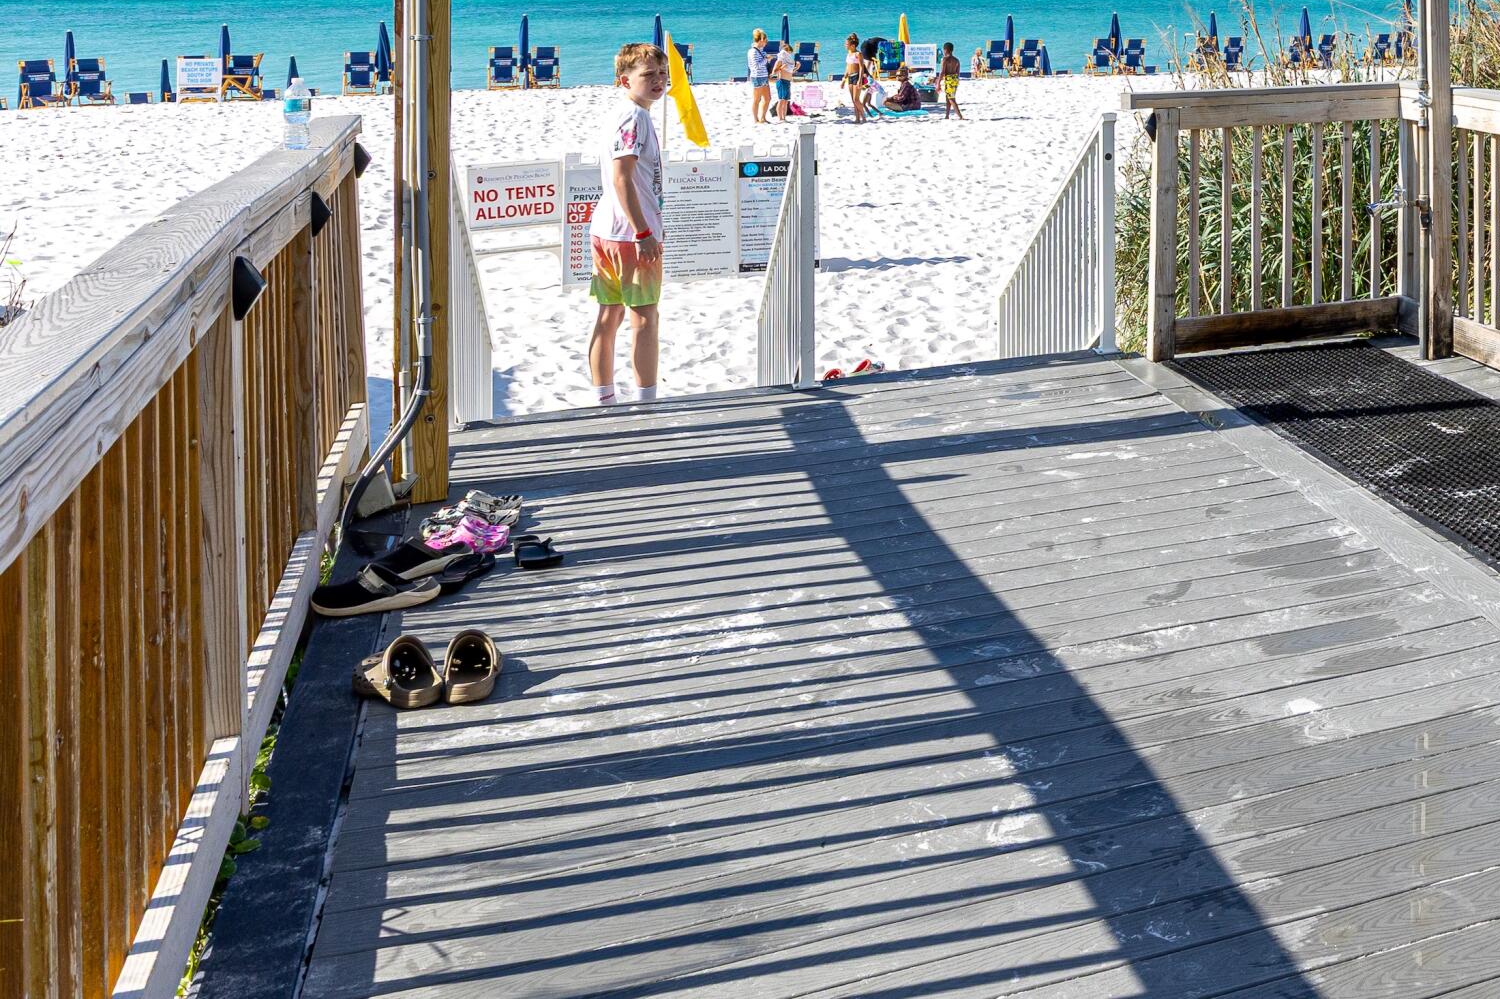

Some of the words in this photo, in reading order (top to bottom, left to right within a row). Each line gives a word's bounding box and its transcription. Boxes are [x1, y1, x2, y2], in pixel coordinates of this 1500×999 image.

[474, 189, 498, 203] NO
[505, 184, 555, 200] TENTS
[476, 202, 554, 220] ALLOWED
[568, 204, 587, 213] NO
[569, 214, 585, 223] OF
